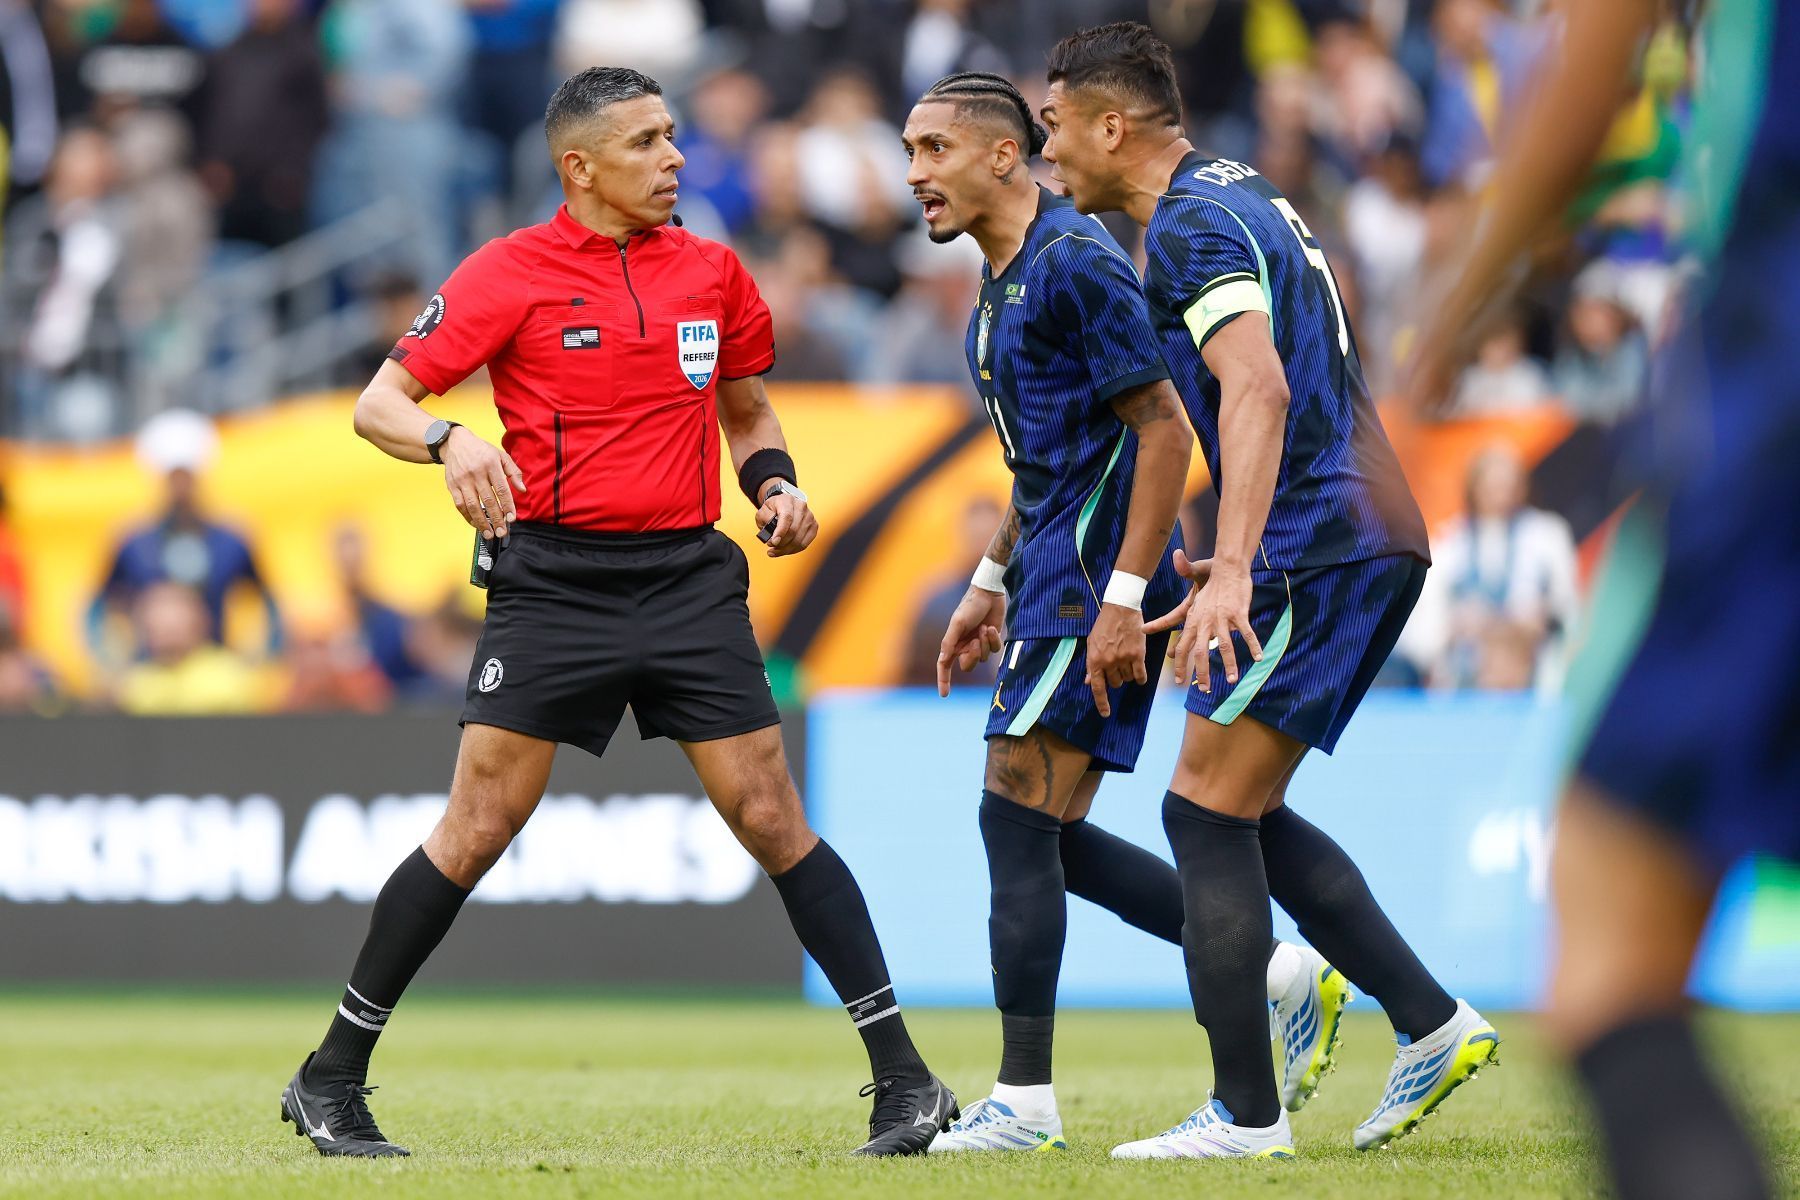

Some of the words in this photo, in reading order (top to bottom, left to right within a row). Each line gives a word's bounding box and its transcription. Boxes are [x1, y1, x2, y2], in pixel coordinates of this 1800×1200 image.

[682, 325, 716, 342] FIFA
[683, 352, 716, 362] REFEREE
[694, 374, 708, 383] 2026
